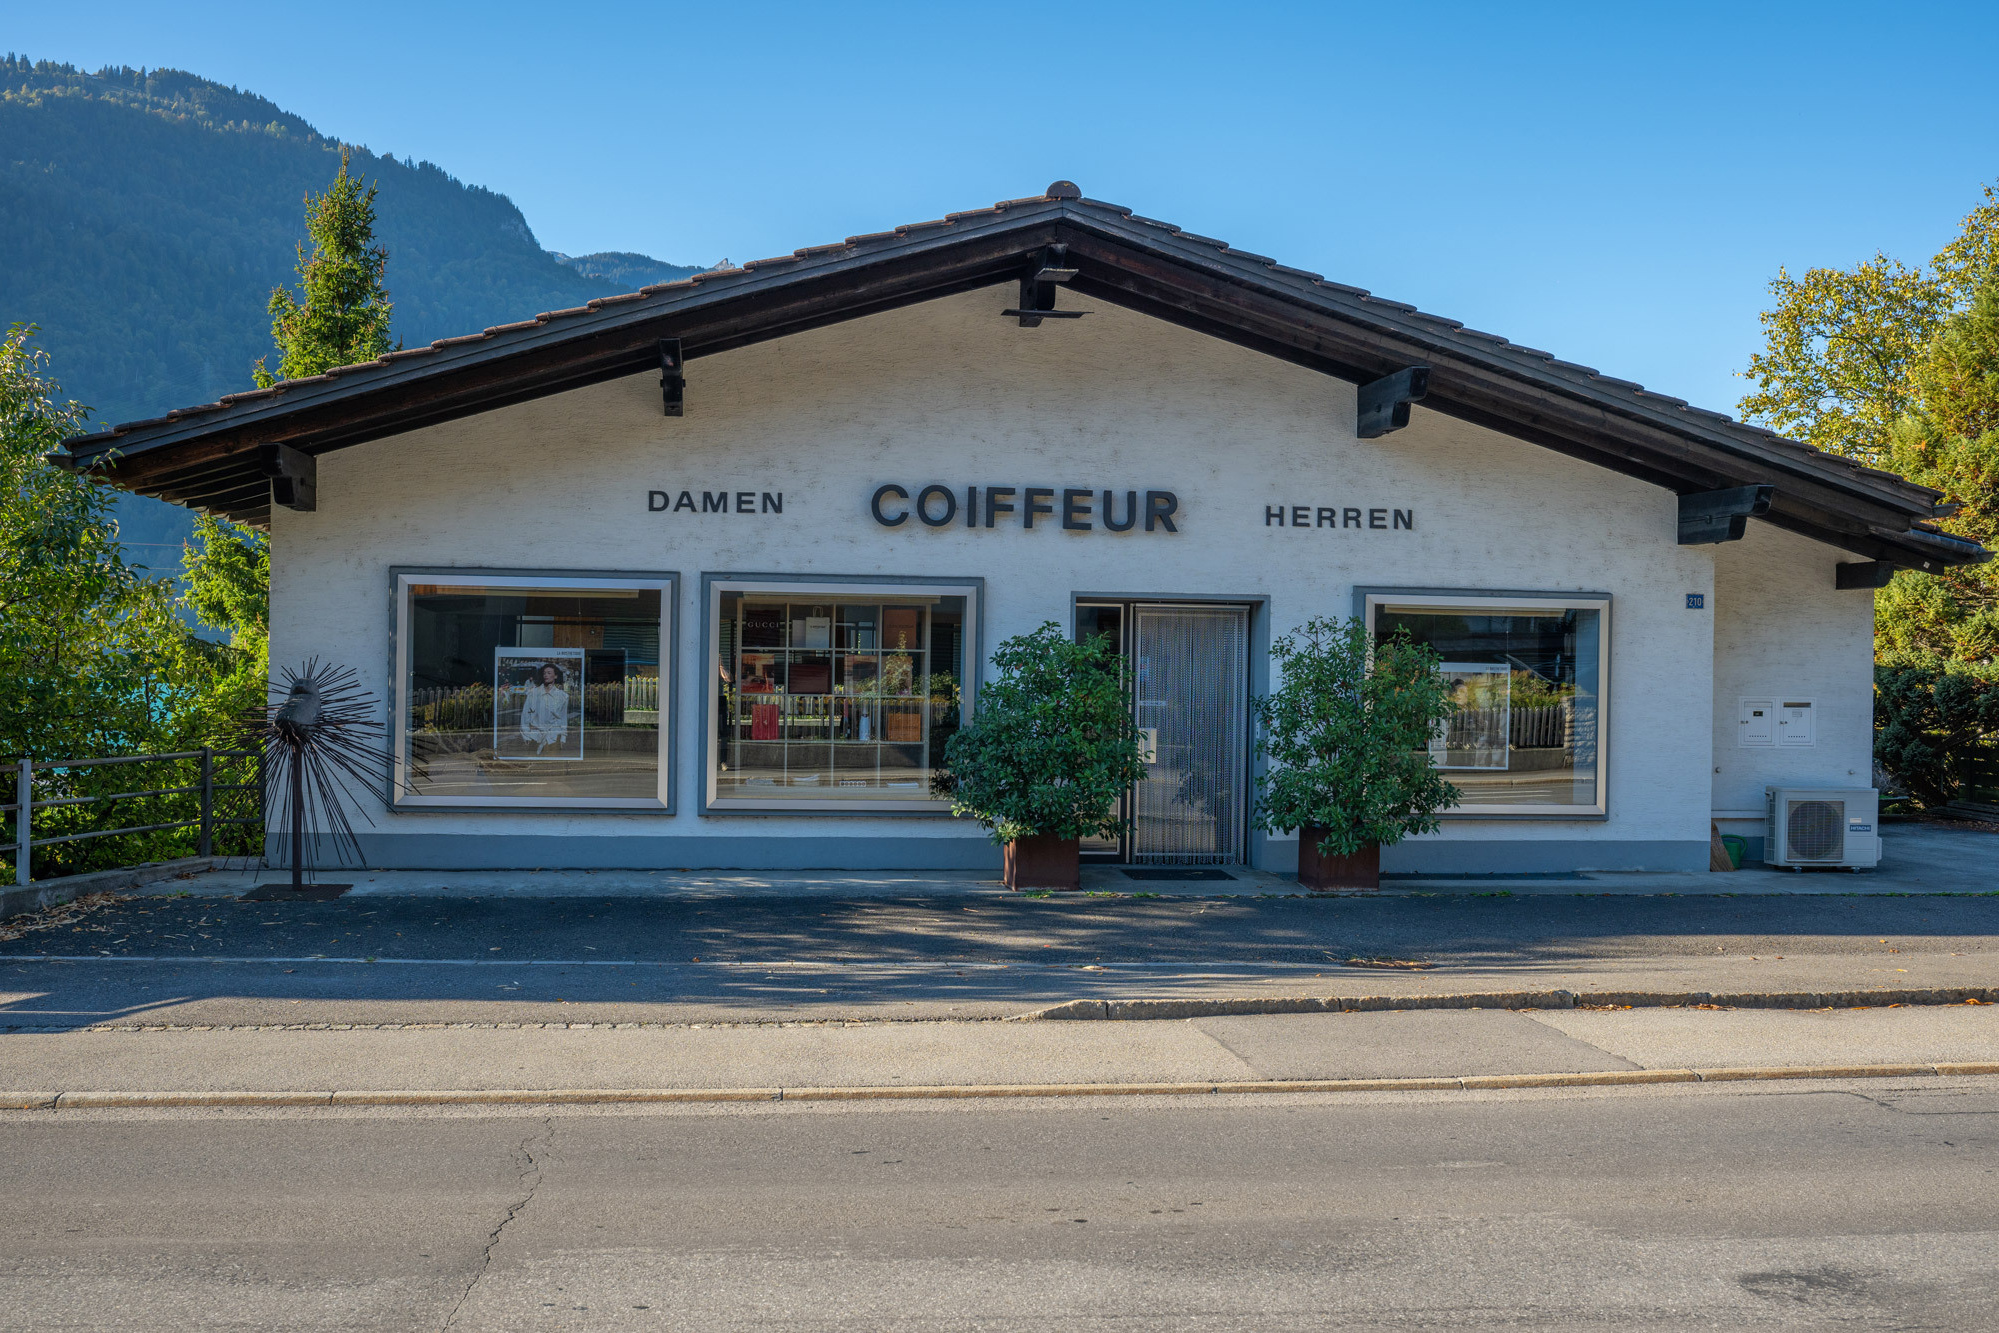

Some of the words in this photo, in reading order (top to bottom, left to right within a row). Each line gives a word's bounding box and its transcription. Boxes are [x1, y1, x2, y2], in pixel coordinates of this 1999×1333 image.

[648, 490, 782, 514] DAMEN
[870, 484, 1178, 533] COIFFEUR
[1266, 506, 1413, 530] HERREN
[1689, 597, 1702, 607] 210
